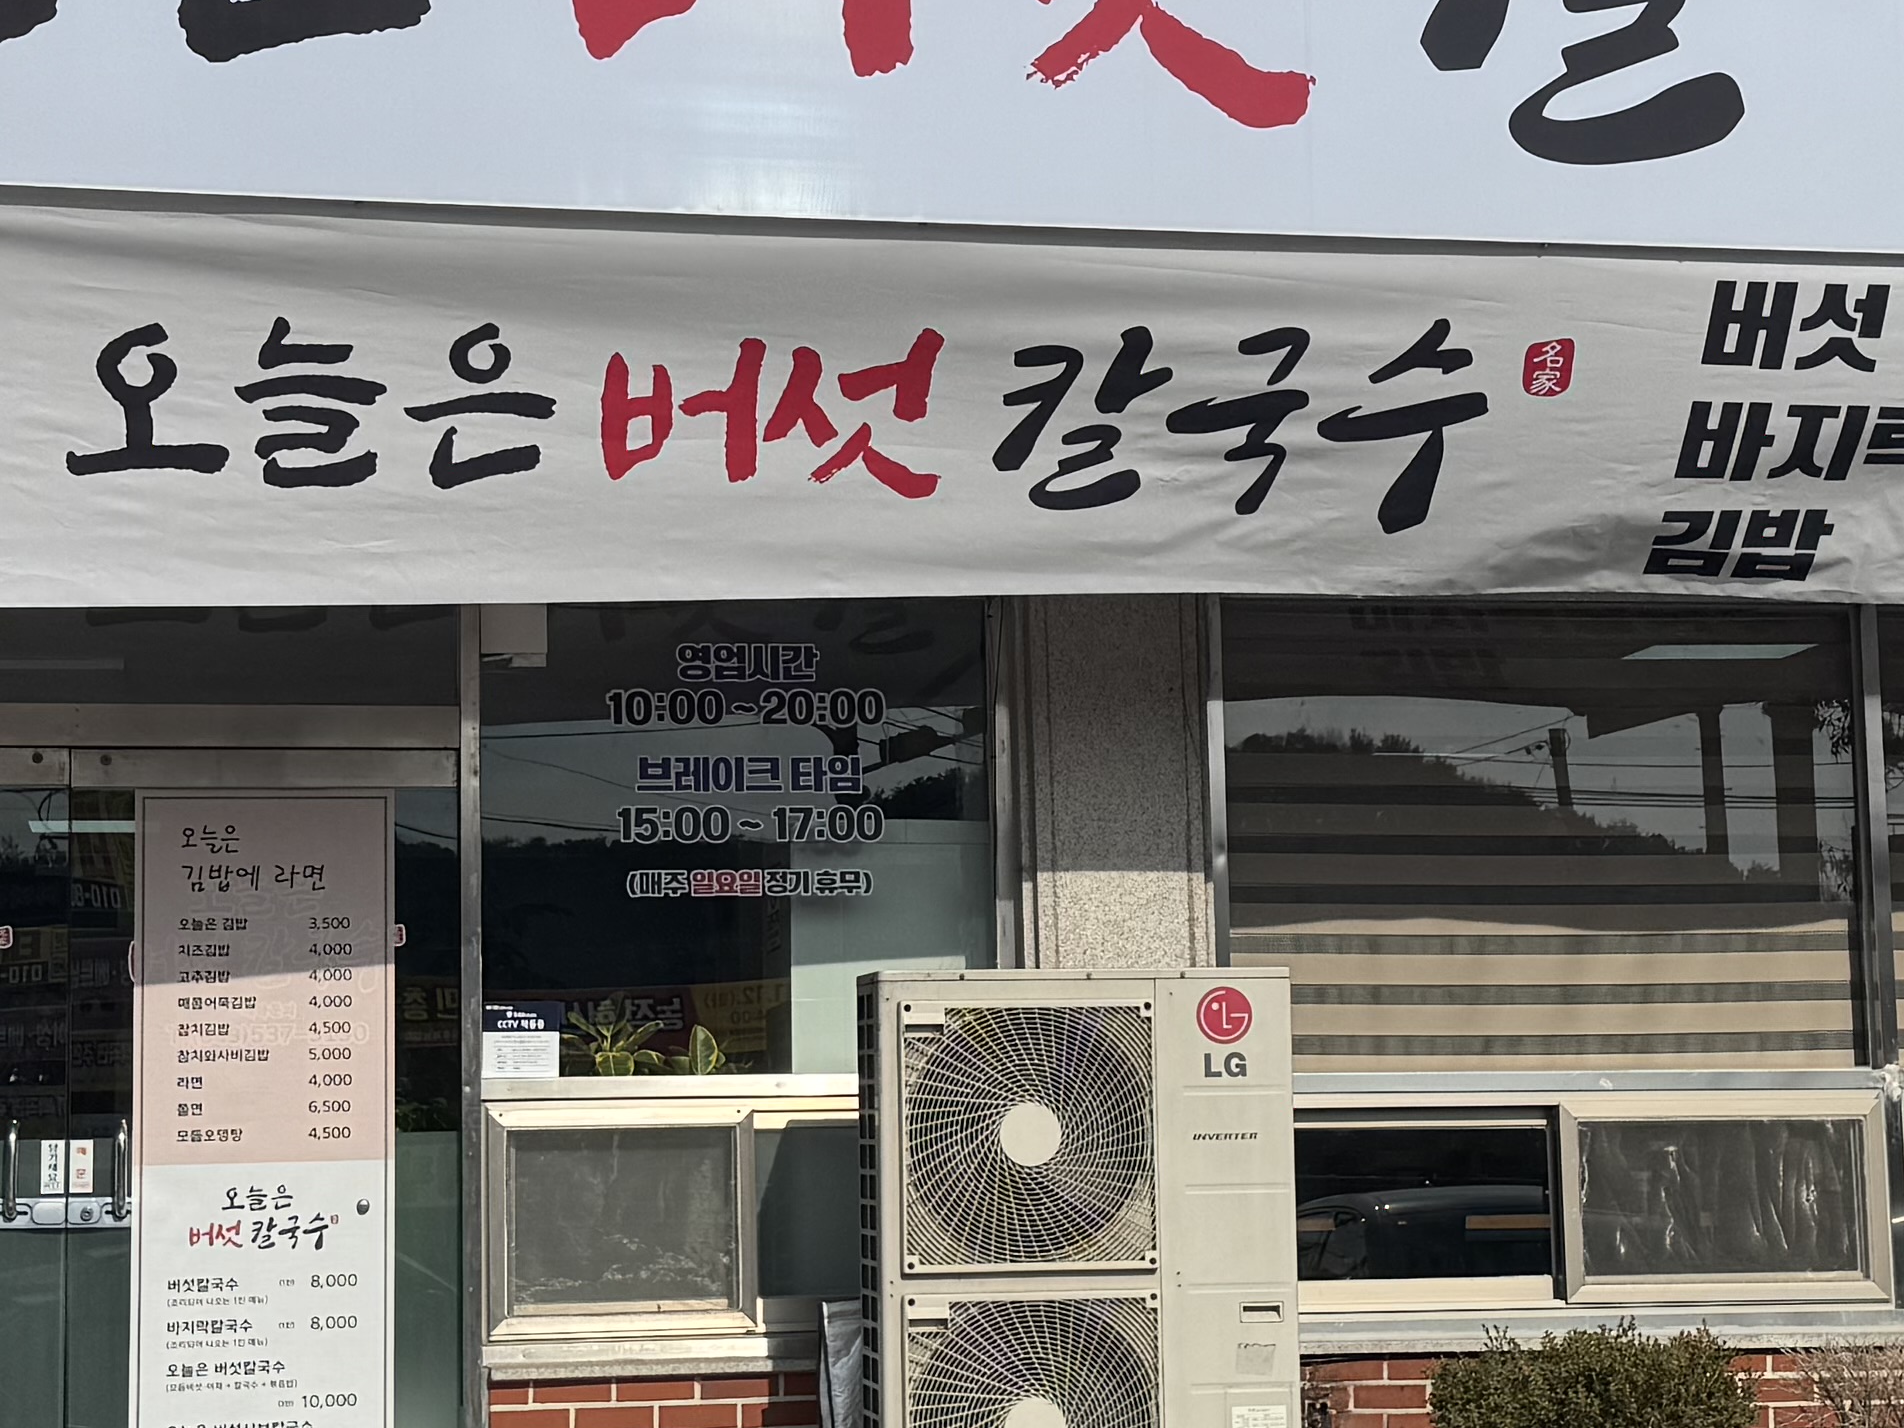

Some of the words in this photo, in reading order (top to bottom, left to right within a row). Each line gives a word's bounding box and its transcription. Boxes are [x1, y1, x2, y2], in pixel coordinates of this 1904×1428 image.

[1699, 280, 1893, 372] 버섯
[65, 315, 557, 489] 오늘은
[599, 327, 946, 500] 버섯
[993, 318, 1493, 534] 칼국수
[1642, 508, 1834, 582] 김밥
[676, 643, 820, 683] 영업시간
[606, 689, 725, 727] 10:00
[760, 689, 887, 727] 20:00
[636, 755, 784, 794] 브레이크
[789, 755, 863, 794] 타임
[616, 805, 731, 844] 15:00
[771, 805, 885, 844] 17:00
[180, 824, 241, 854] 오늘은
[181, 864, 260, 893] 김밥에
[274, 863, 327, 892] 라면
[627, 870, 689, 897] (매주
[690, 870, 763, 897] 일요일
[764, 870, 812, 897] 정기
[813, 870, 873, 897] 휴무)
[177, 918, 218, 931] 오늘은
[222, 917, 248, 931] 김밥
[308, 917, 351, 931] 3,500
[178, 944, 231, 957] 치즈김밥
[308, 943, 353, 957] 4,000
[308, 968, 353, 984] 4,000
[308, 995, 353, 1009] 4,000
[308, 1021, 352, 1035] 4,500
[497, 1020, 519, 1029] CCTV
[308, 1047, 352, 1061] 5,000
[1203, 1052, 1248, 1079] LG
[177, 1076, 203, 1090] 라면
[308, 1074, 353, 1088] 4,000
[308, 1100, 351, 1114] 6,500
[308, 1126, 351, 1140] 4,500
[1192, 1132, 1258, 1140] INVERTER
[221, 1184, 294, 1212] 오늘은
[189, 1220, 243, 1248] 버섯
[250, 1212, 331, 1250] 칼국수
[167, 1277, 239, 1293] 버섯칼국수
[311, 1274, 358, 1289] 8,000
[310, 1315, 358, 1331] 8,000
[166, 1362, 208, 1378] 오늘은
[215, 1360, 286, 1376] 버섯칼국수
[302, 1393, 357, 1409] 10,000
